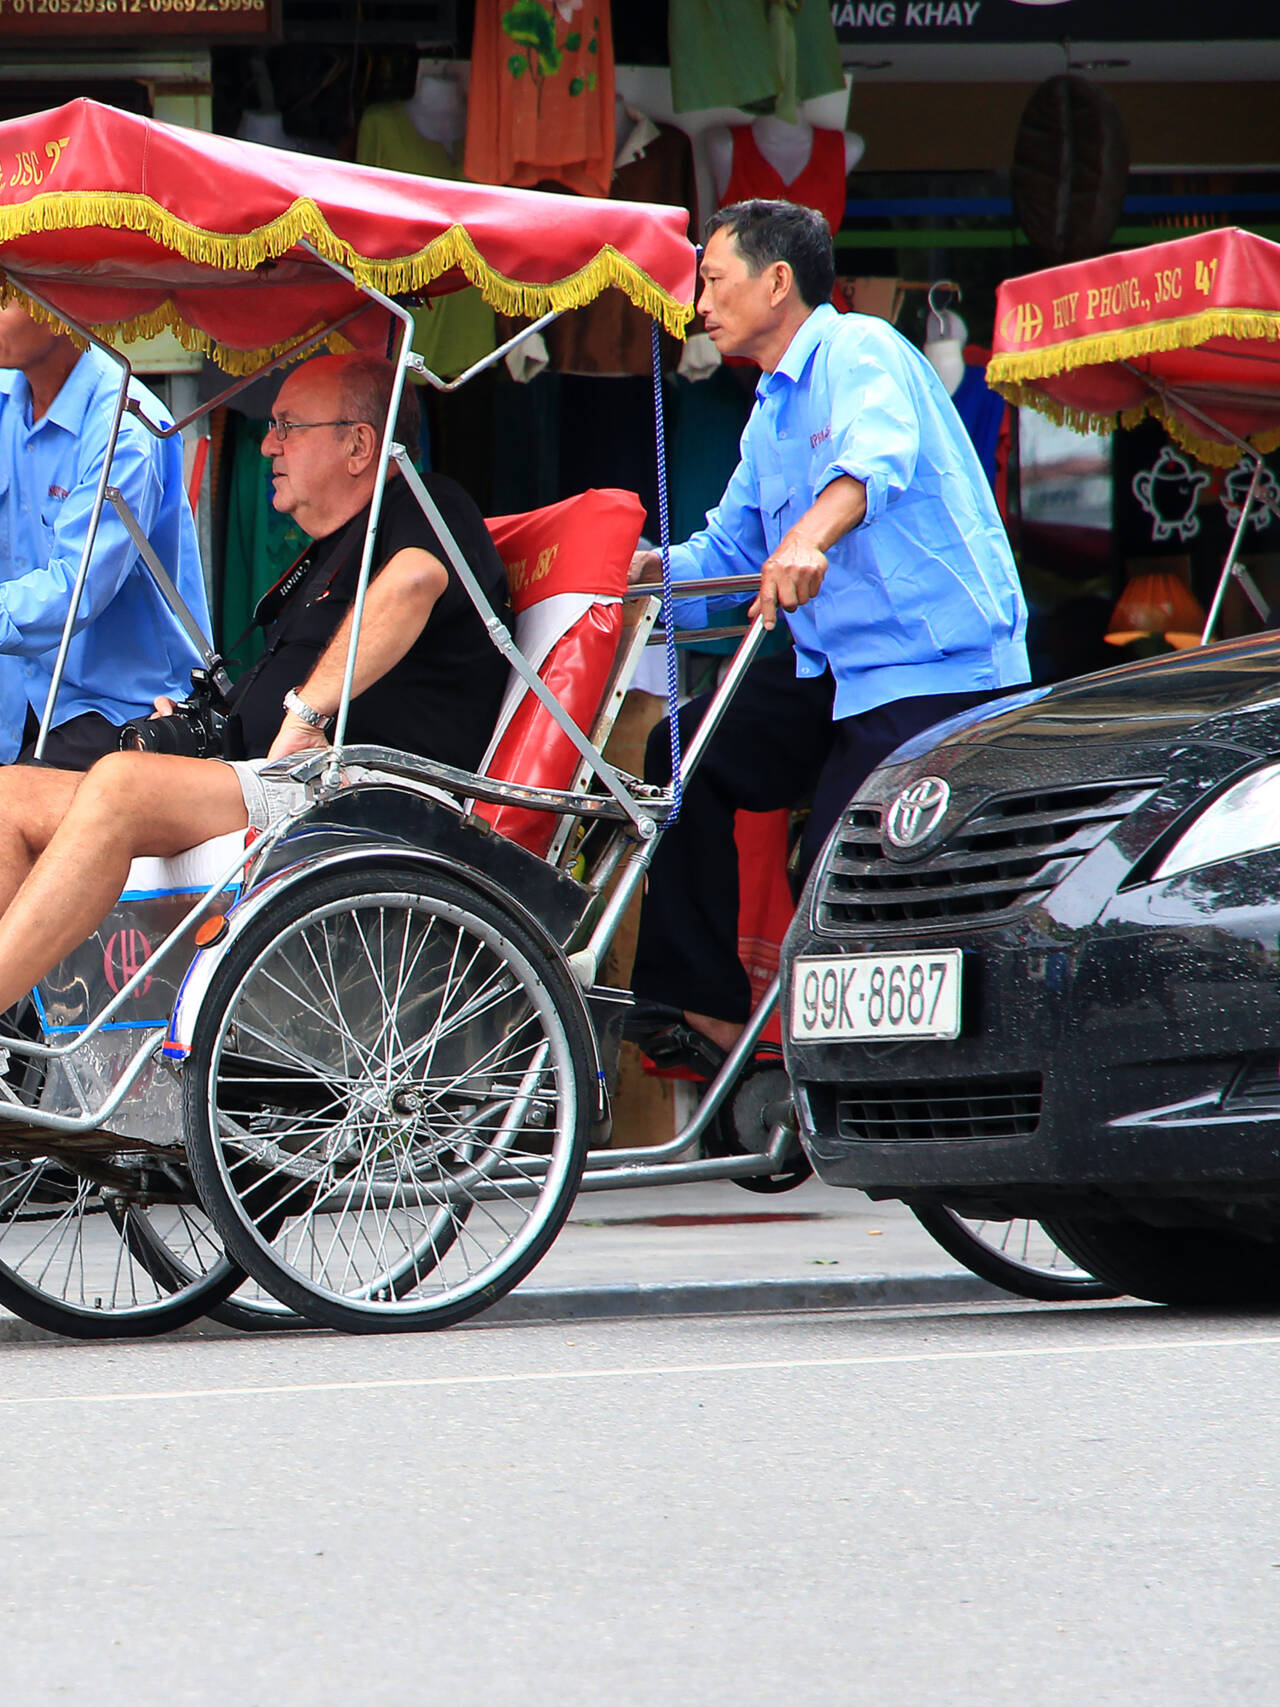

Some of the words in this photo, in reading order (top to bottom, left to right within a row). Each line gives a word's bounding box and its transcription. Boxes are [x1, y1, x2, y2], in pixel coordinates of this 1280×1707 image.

[904, 2, 981, 27] KHAY
[10, 151, 44, 188] JSC
[1052, 291, 1080, 330] HUY
[1153, 266, 1183, 303] JSC
